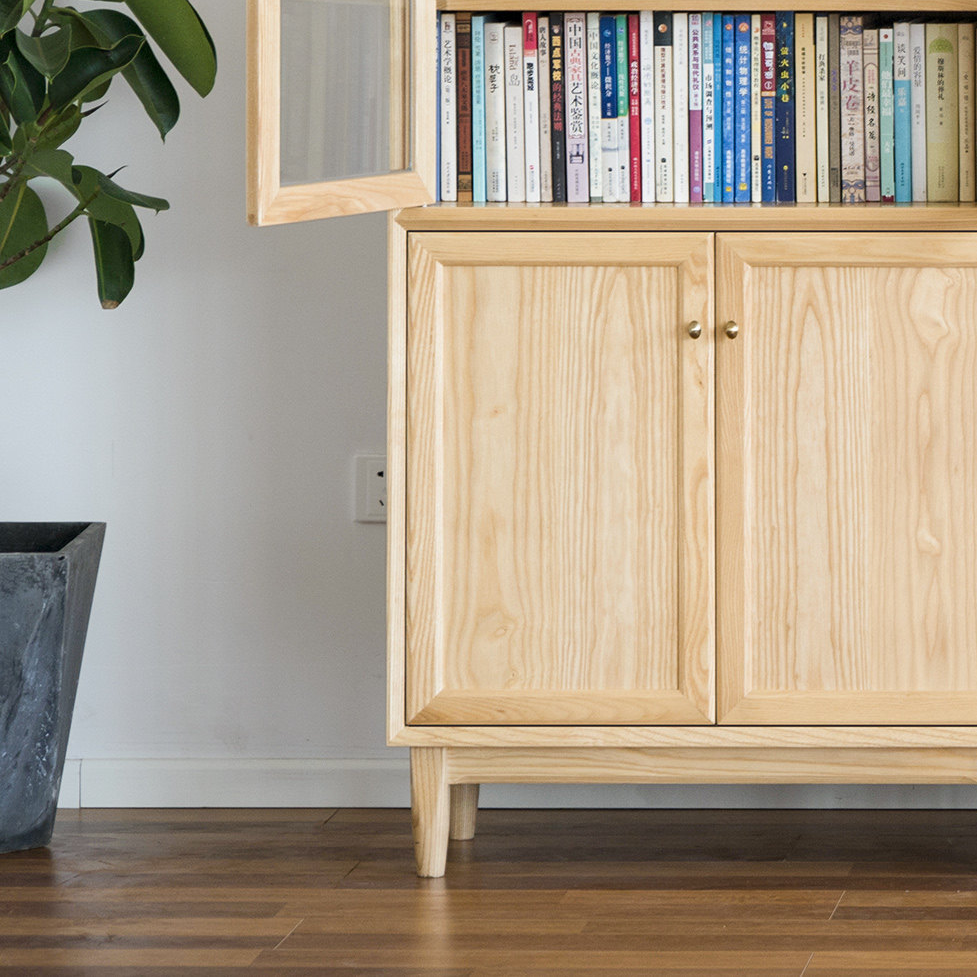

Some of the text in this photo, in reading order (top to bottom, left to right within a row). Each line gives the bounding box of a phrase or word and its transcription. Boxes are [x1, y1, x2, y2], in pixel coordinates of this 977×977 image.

[443, 39, 453, 84] 艺术学概论
[551, 34, 563, 132] 西点军校的经典法则
[568, 23, 584, 134] 中国古典家具艺术鉴赏
[589, 31, 600, 90] 中国文化概论
[691, 29, 700, 91] 公共关系与现代礼仪
[738, 45, 749, 98] 统计物理学
[780, 46, 790, 103] 萤火虫小巷
[843, 60, 860, 112] 羊皮卷
[896, 42, 907, 78] 谈笑间
[936, 57, 945, 101] 穆斯林的葬礼
[705, 74, 713, 131] 市场调查与预测
[866, 92, 877, 141] 诗经名篇
